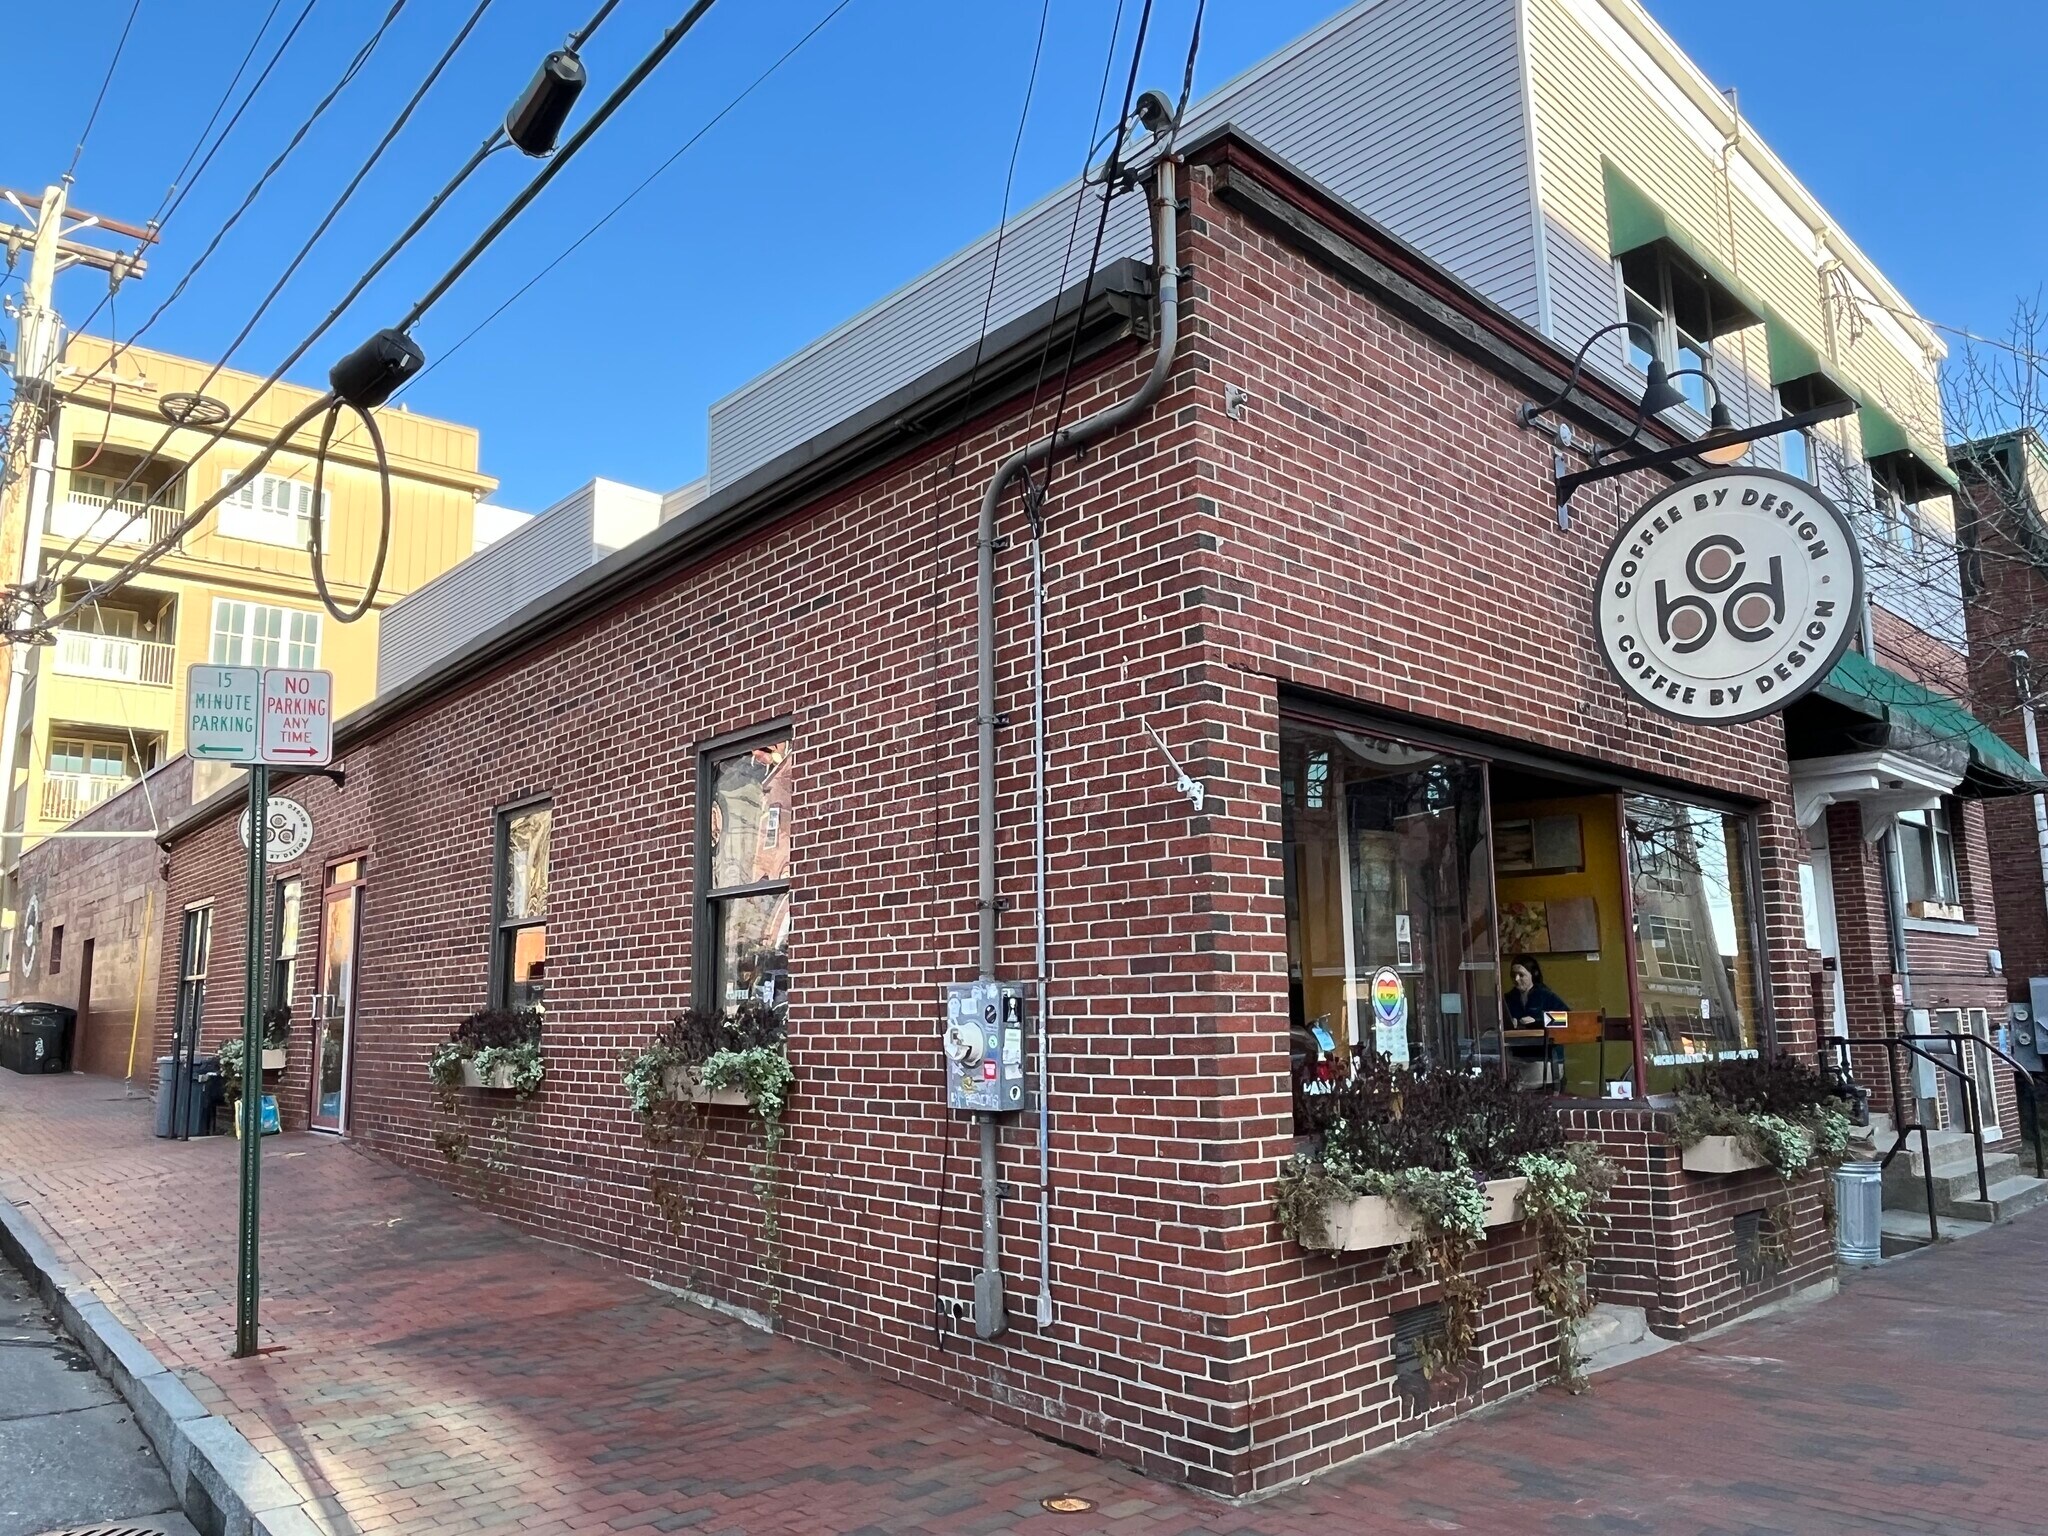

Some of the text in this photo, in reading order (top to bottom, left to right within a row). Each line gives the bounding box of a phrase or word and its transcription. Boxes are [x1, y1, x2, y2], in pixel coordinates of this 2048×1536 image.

[1614, 487, 1829, 599] COFFEE BY DESIGN
[1618, 600, 1836, 707] COFFEE BY DESIGN
[218, 672, 232, 688] 15
[285, 677, 310, 695] NO
[195, 693, 252, 711] MINUTE
[267, 697, 326, 716] PARKING
[192, 715, 253, 733] PARKING
[283, 718, 310, 729] ANY
[280, 731, 312, 743] TIME
